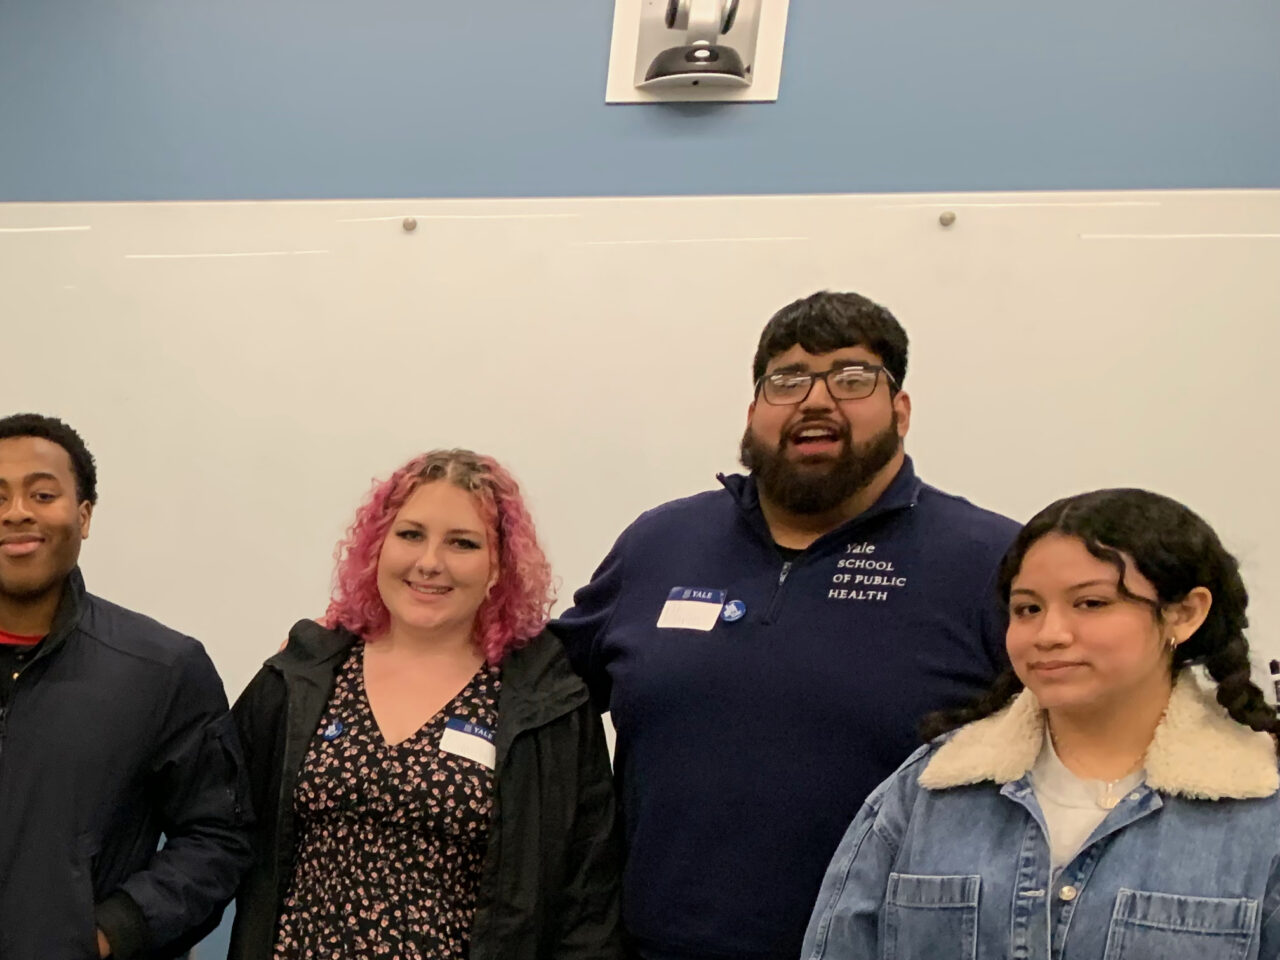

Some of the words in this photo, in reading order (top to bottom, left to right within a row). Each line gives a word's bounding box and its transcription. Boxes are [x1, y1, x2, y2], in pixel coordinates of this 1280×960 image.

[846, 542, 875, 554] Yale
[837, 559, 895, 571] SCHOOL
[833, 574, 851, 583] OF
[855, 574, 907, 586] PUBLIC
[692, 590, 713, 599] YALE
[828, 589, 888, 600] HEALTH
[474, 727, 493, 740] YALE
